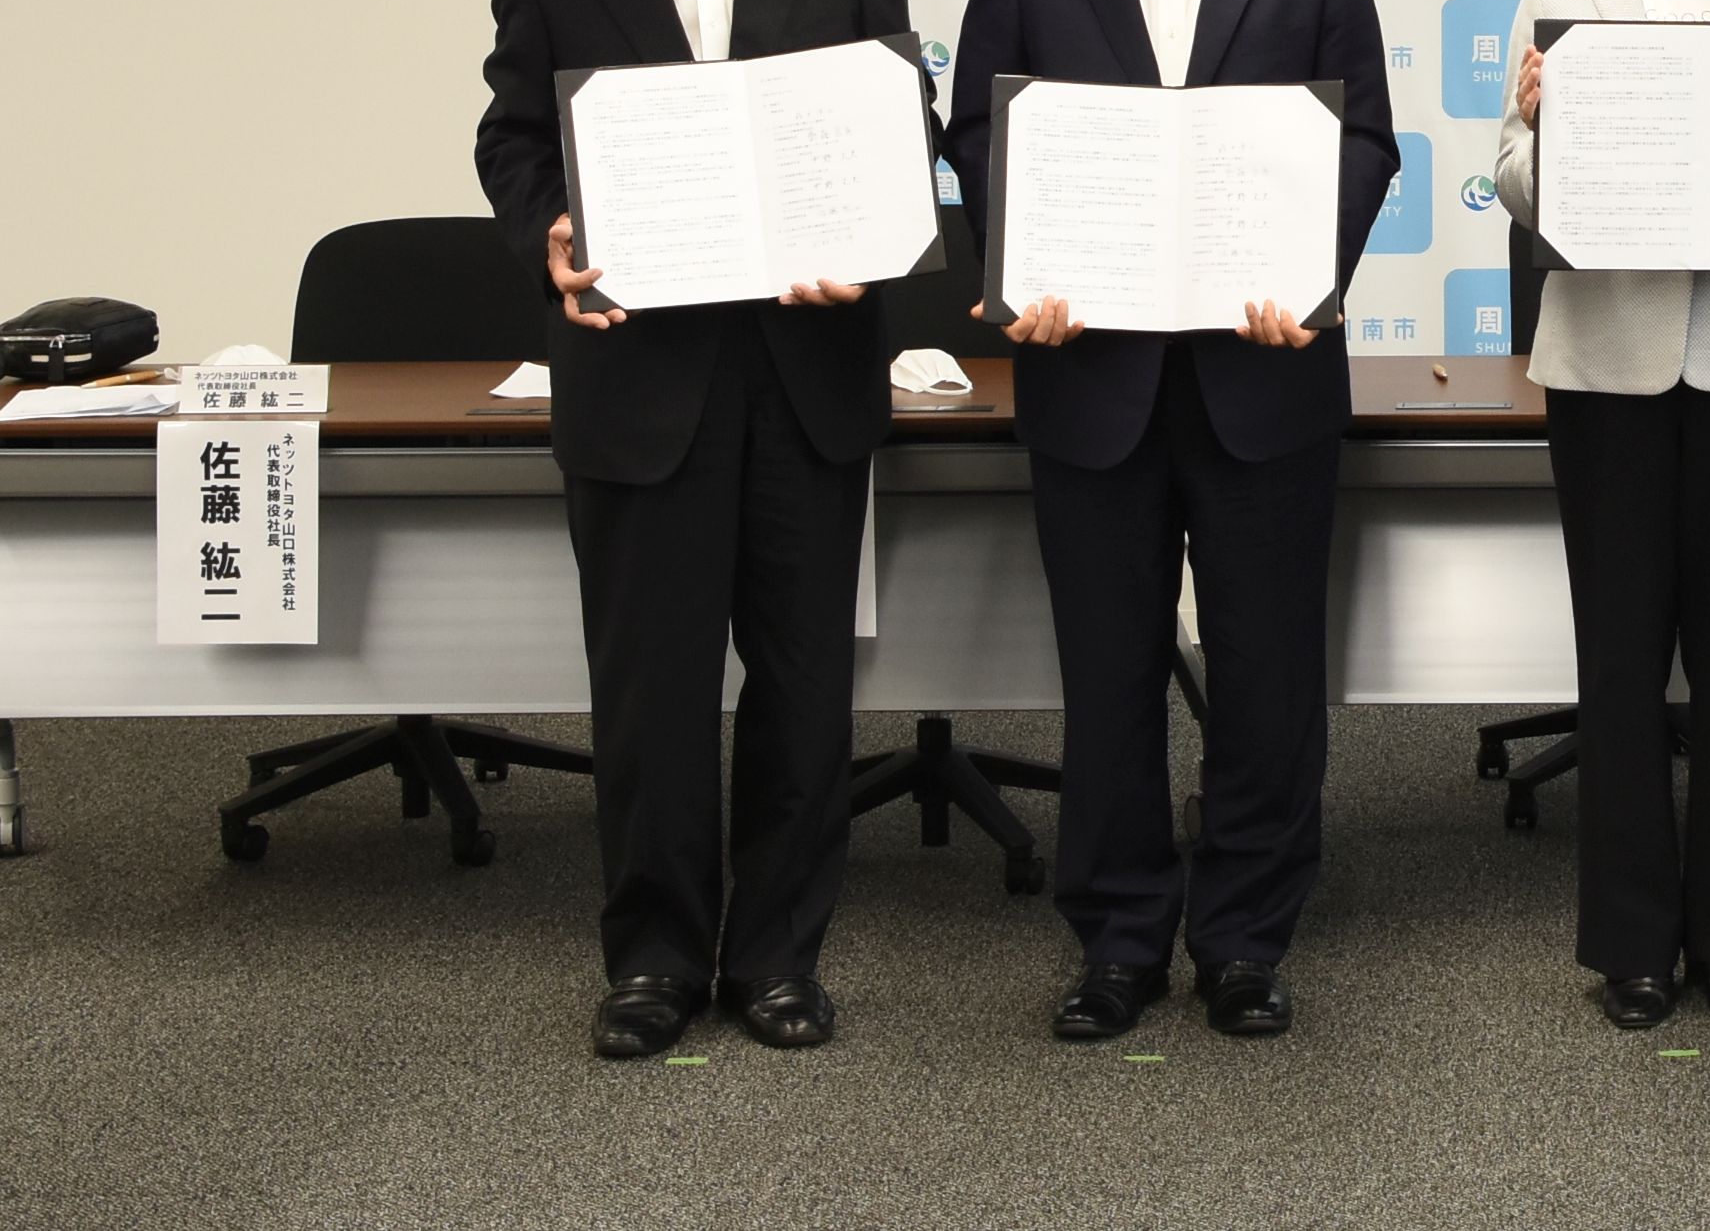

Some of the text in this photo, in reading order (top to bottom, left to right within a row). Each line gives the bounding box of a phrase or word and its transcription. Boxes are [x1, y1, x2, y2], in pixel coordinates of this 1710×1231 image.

[1473, 71, 1503, 82] SHU
[1346, 317, 1416, 341] 南市
[197, 382, 257, 391] 代表取締役社長
[200, 441, 241, 524] 佐藤
[267, 444, 281, 547] 代表取締役社長
[282, 433, 296, 611] ネッツトヨタ山口株式会社
